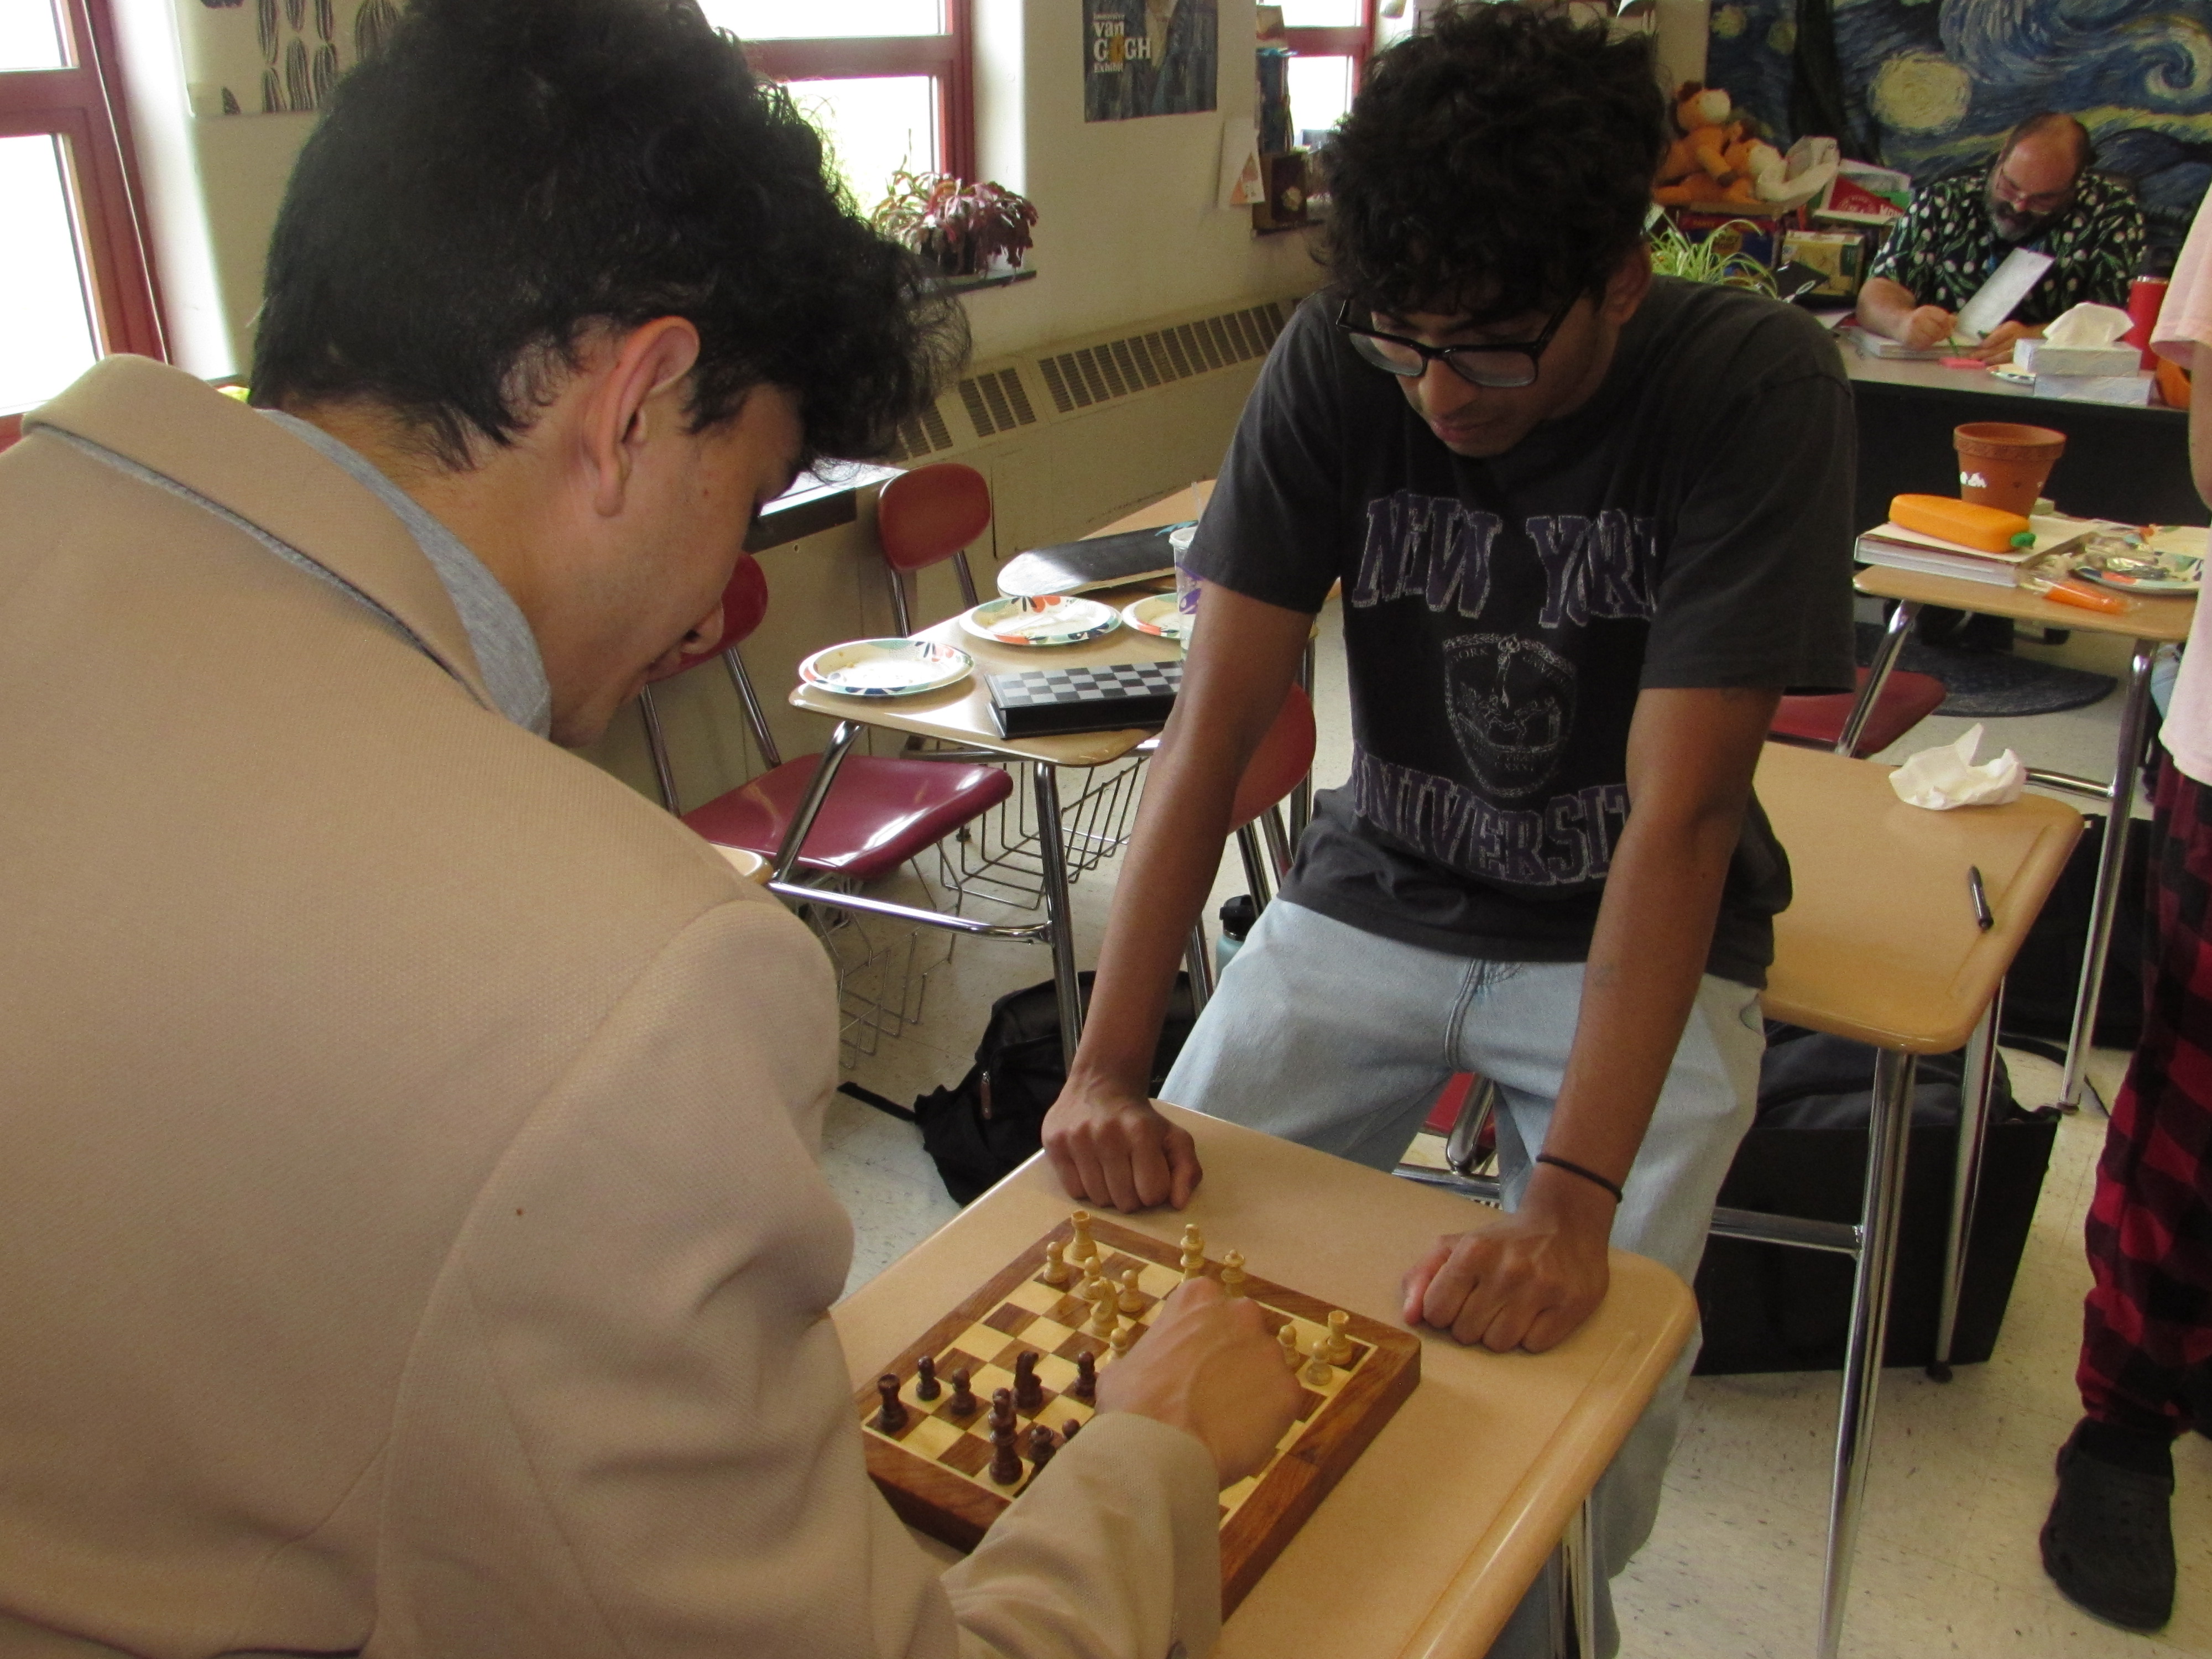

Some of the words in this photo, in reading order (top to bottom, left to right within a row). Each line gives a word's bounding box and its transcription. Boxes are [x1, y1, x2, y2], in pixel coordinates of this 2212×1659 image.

[1093, 21, 1124, 37] van
[1352, 489, 1503, 619] NEW
[1352, 742, 1632, 885] UNIVERSIT
